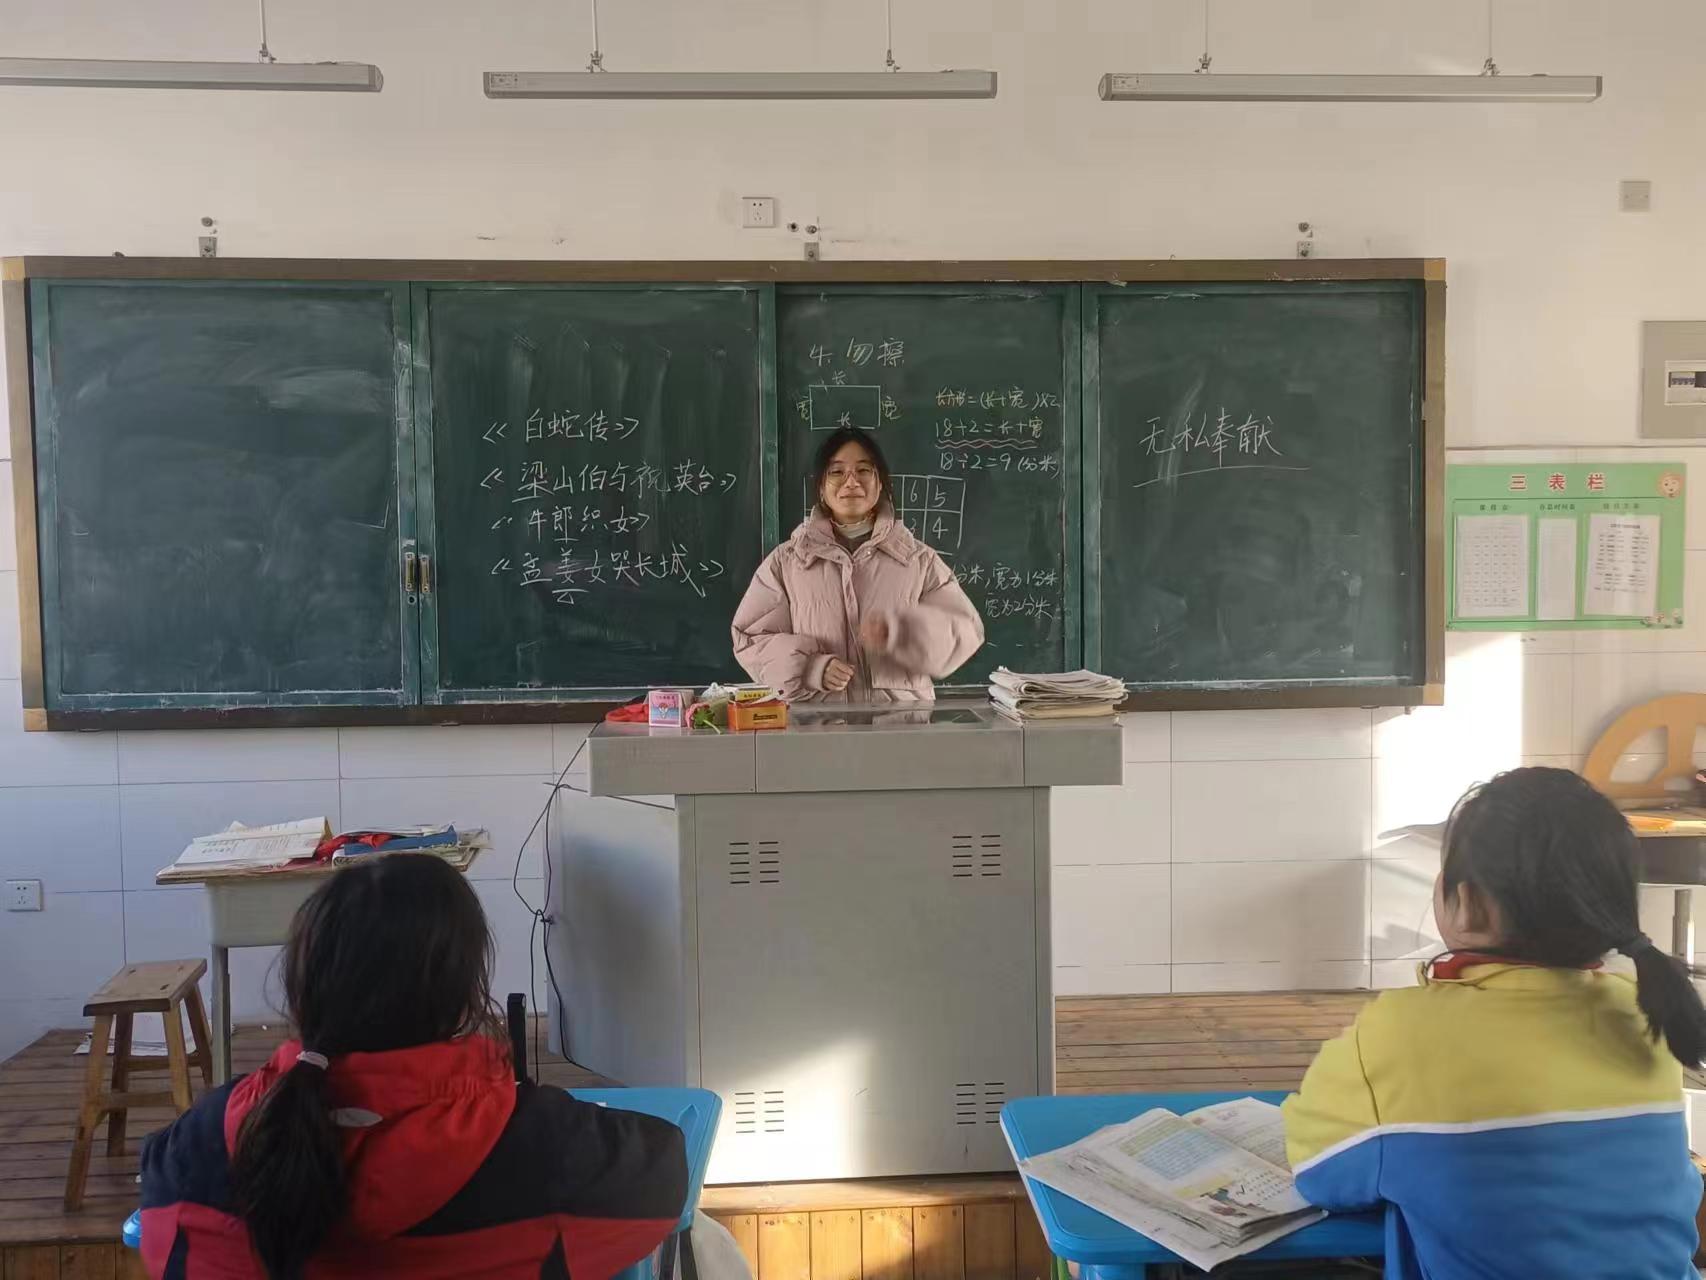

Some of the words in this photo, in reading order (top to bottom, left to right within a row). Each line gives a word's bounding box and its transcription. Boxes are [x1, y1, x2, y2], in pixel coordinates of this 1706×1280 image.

[1139, 407, 1283, 468] 无私奉献
[910, 480, 918, 502] 6
[932, 484, 947, 508] 5
[1510, 473, 1604, 491] 三表栏
[932, 516, 949, 540] 4
